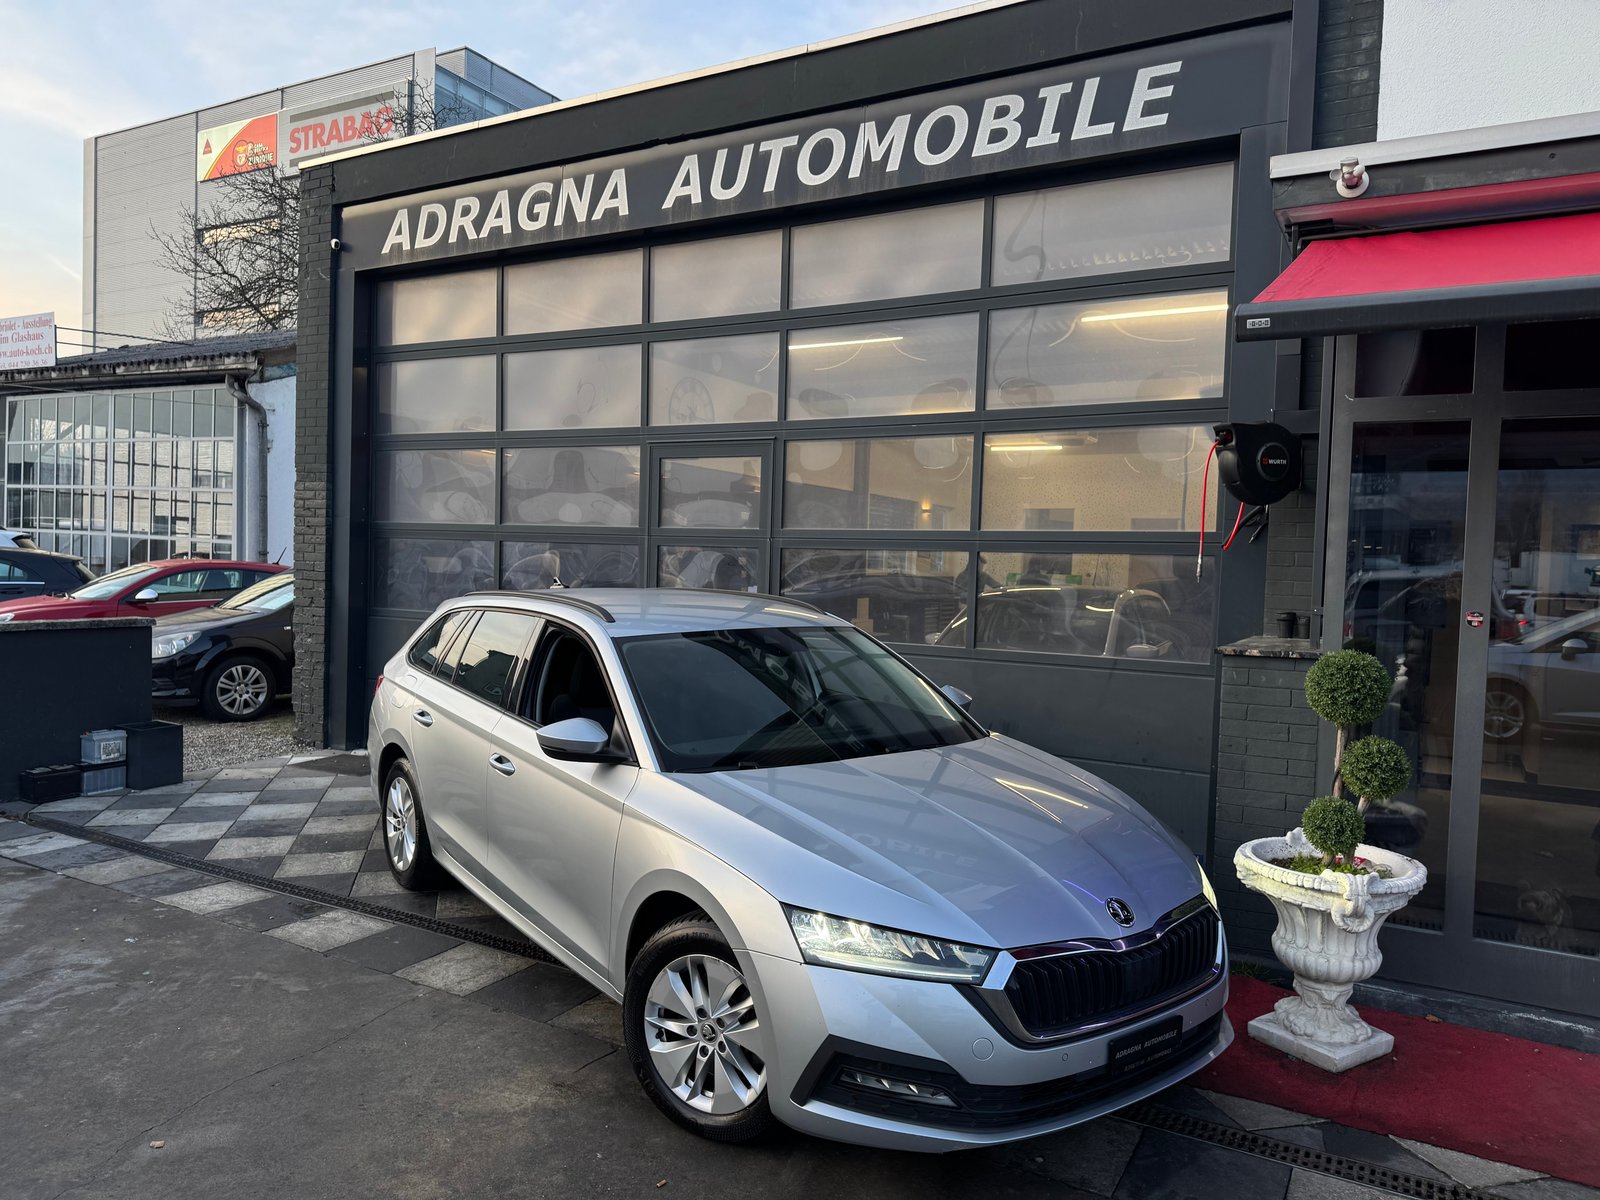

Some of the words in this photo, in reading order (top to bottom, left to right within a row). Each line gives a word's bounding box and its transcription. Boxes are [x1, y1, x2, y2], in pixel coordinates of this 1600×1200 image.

[289, 106, 394, 154] STRABAG
[381, 168, 629, 255] ADRAGNA
[662, 60, 1183, 210] AUTOMOBILE
[11, 331, 45, 343] Glashaus
[1115, 1043, 1142, 1059] ADRAGNA
[1144, 1029, 1178, 1049] AUTOMOBILE
